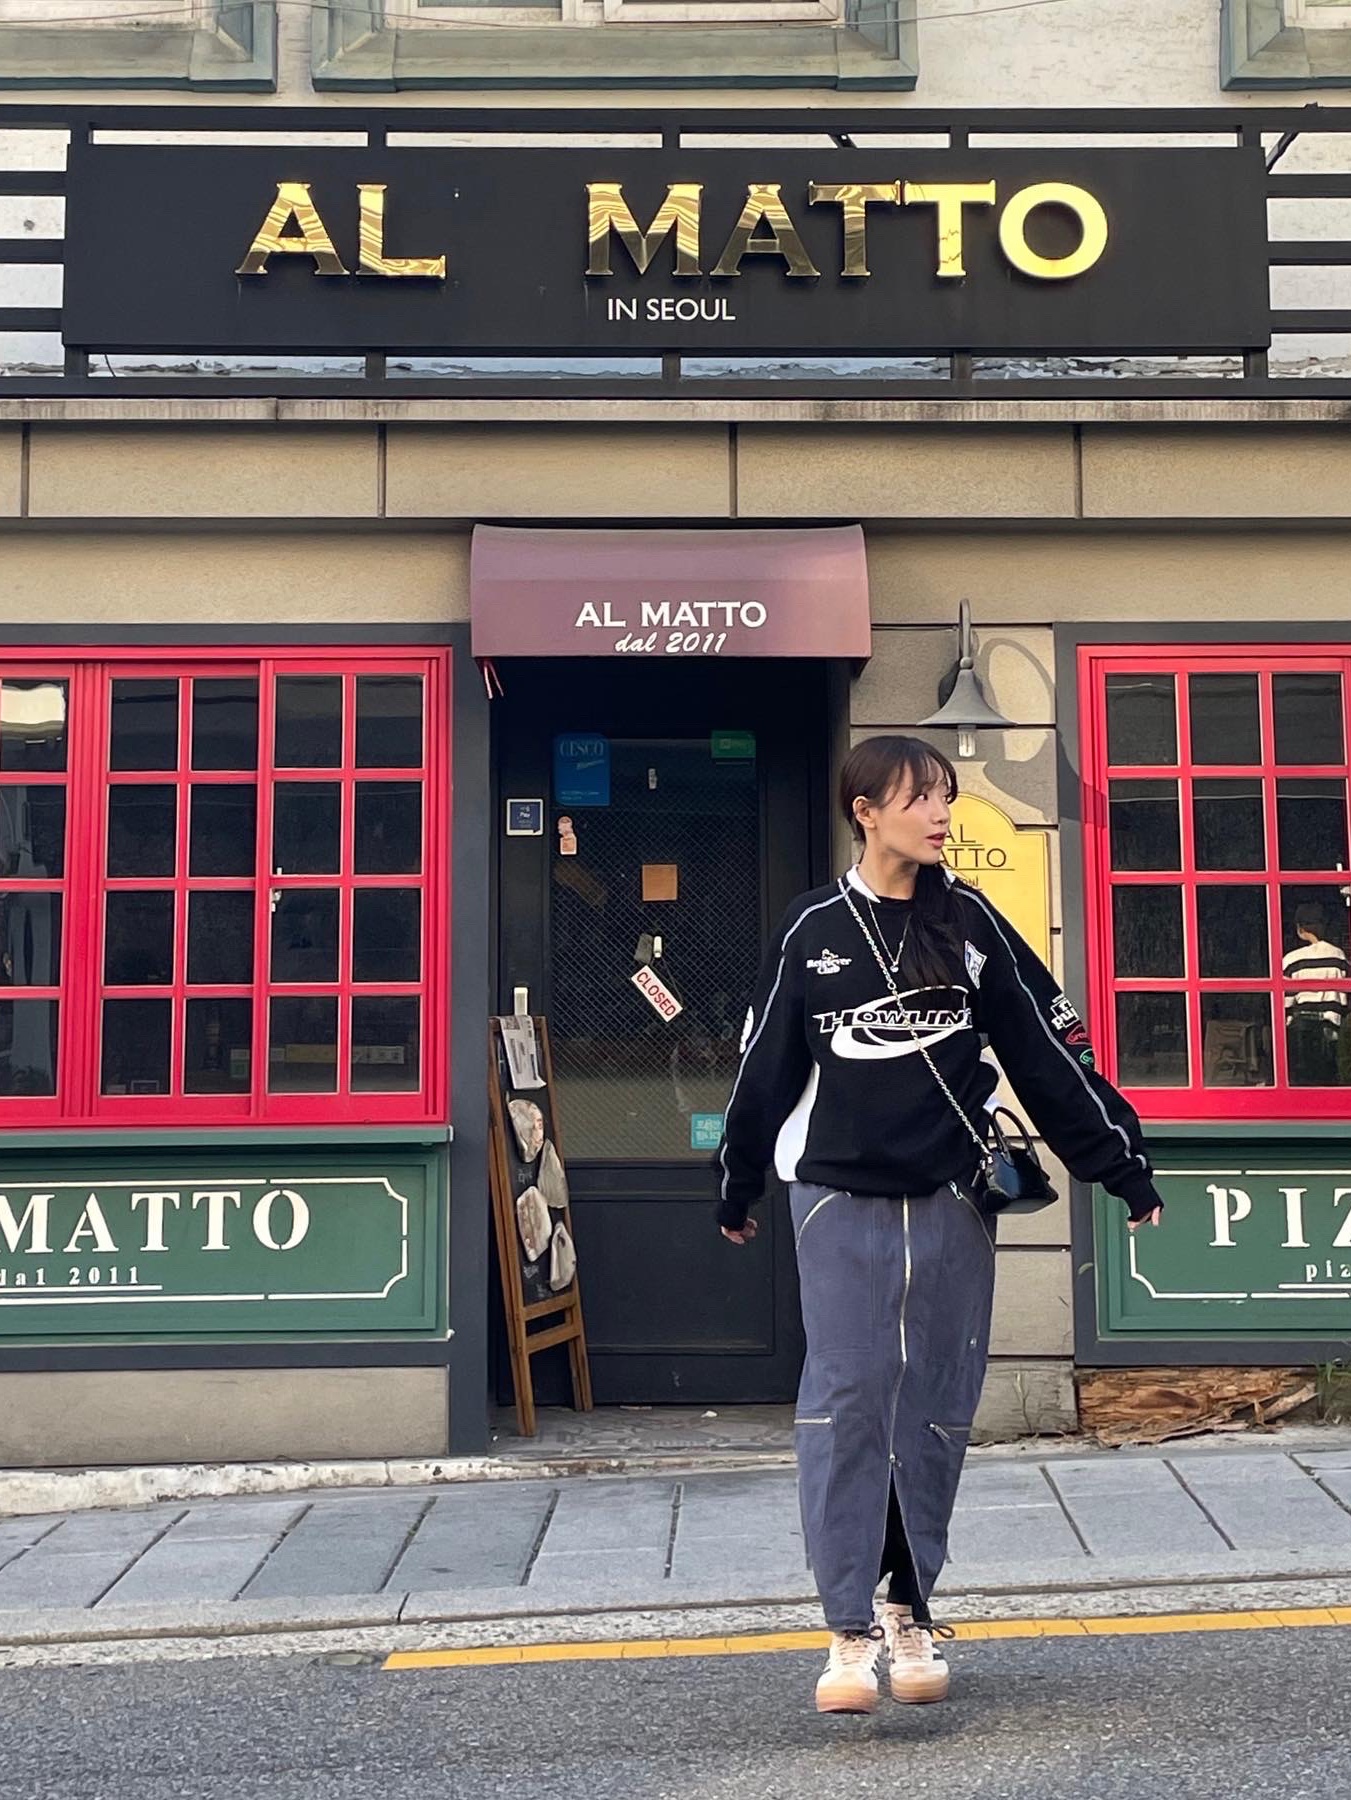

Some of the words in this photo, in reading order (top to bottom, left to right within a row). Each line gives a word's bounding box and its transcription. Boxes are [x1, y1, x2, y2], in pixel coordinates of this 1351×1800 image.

[234, 182, 446, 279] AL
[585, 179, 1109, 279] MATTO
[608, 298, 637, 320] IN
[646, 298, 736, 320] SEOUL
[574, 601, 627, 628] AL
[641, 600, 767, 628] MATTO
[614, 631, 658, 653] dal
[665, 632, 727, 653] 2011
[636, 971, 677, 1017] CLOSED
[68, 1266, 139, 1285] 2011
